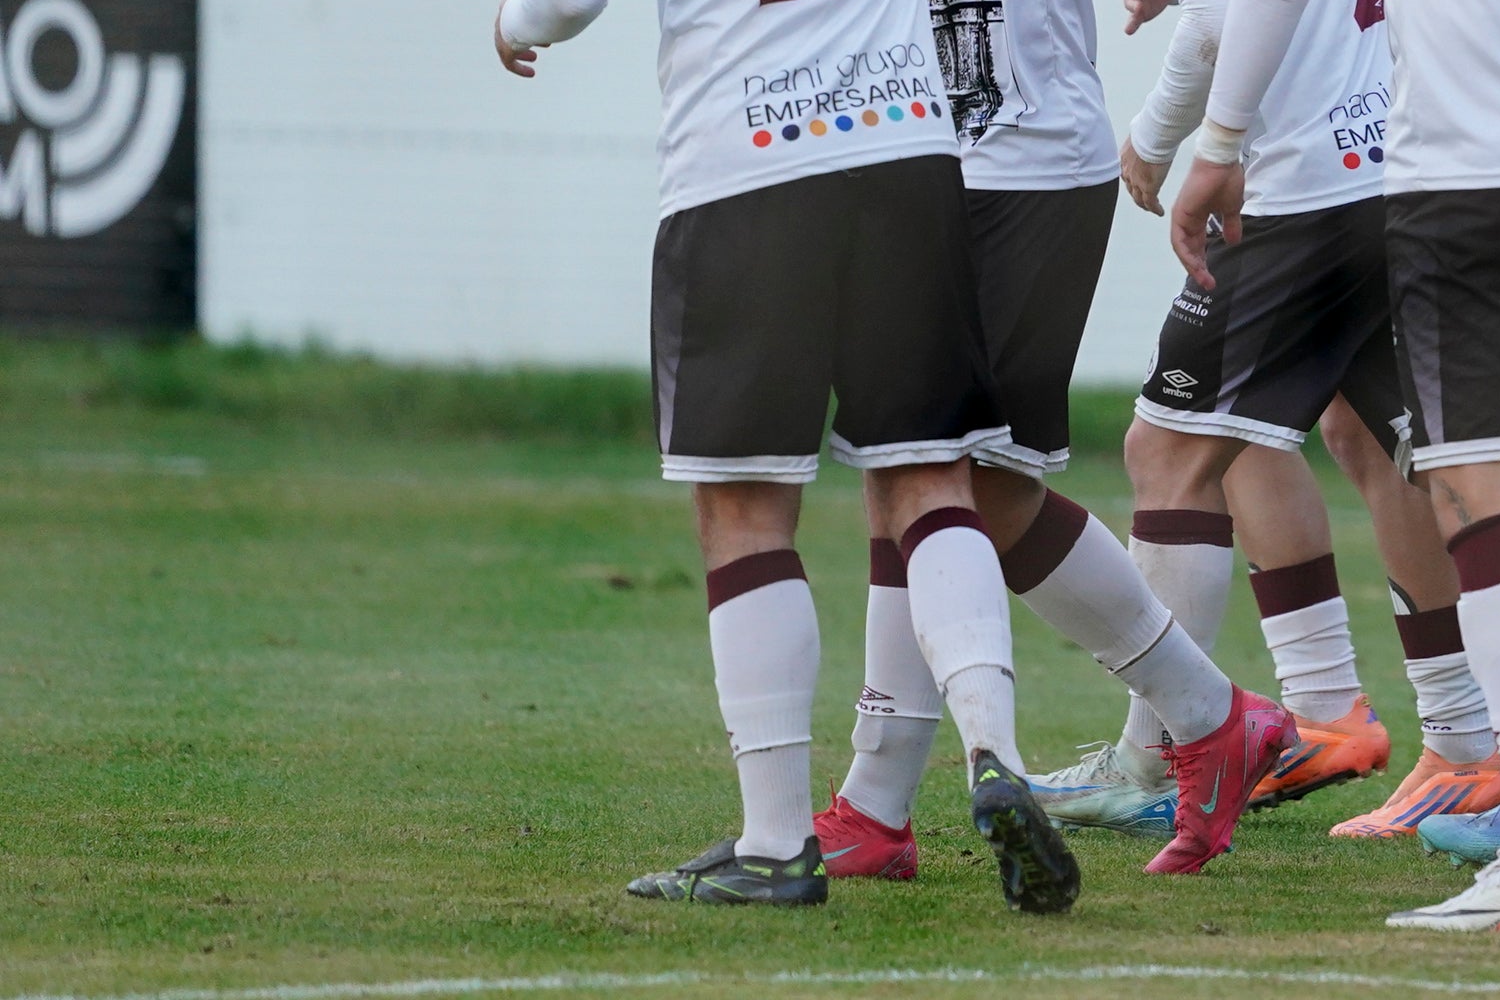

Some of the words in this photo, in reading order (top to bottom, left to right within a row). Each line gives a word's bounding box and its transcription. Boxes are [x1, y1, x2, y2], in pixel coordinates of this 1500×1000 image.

[744, 59, 824, 97] nani
[836, 43, 926, 88] grupo
[746, 76, 938, 128] EMPRESARIAL
[1328, 81, 1394, 124] nani
[1162, 386, 1193, 400] umbro
